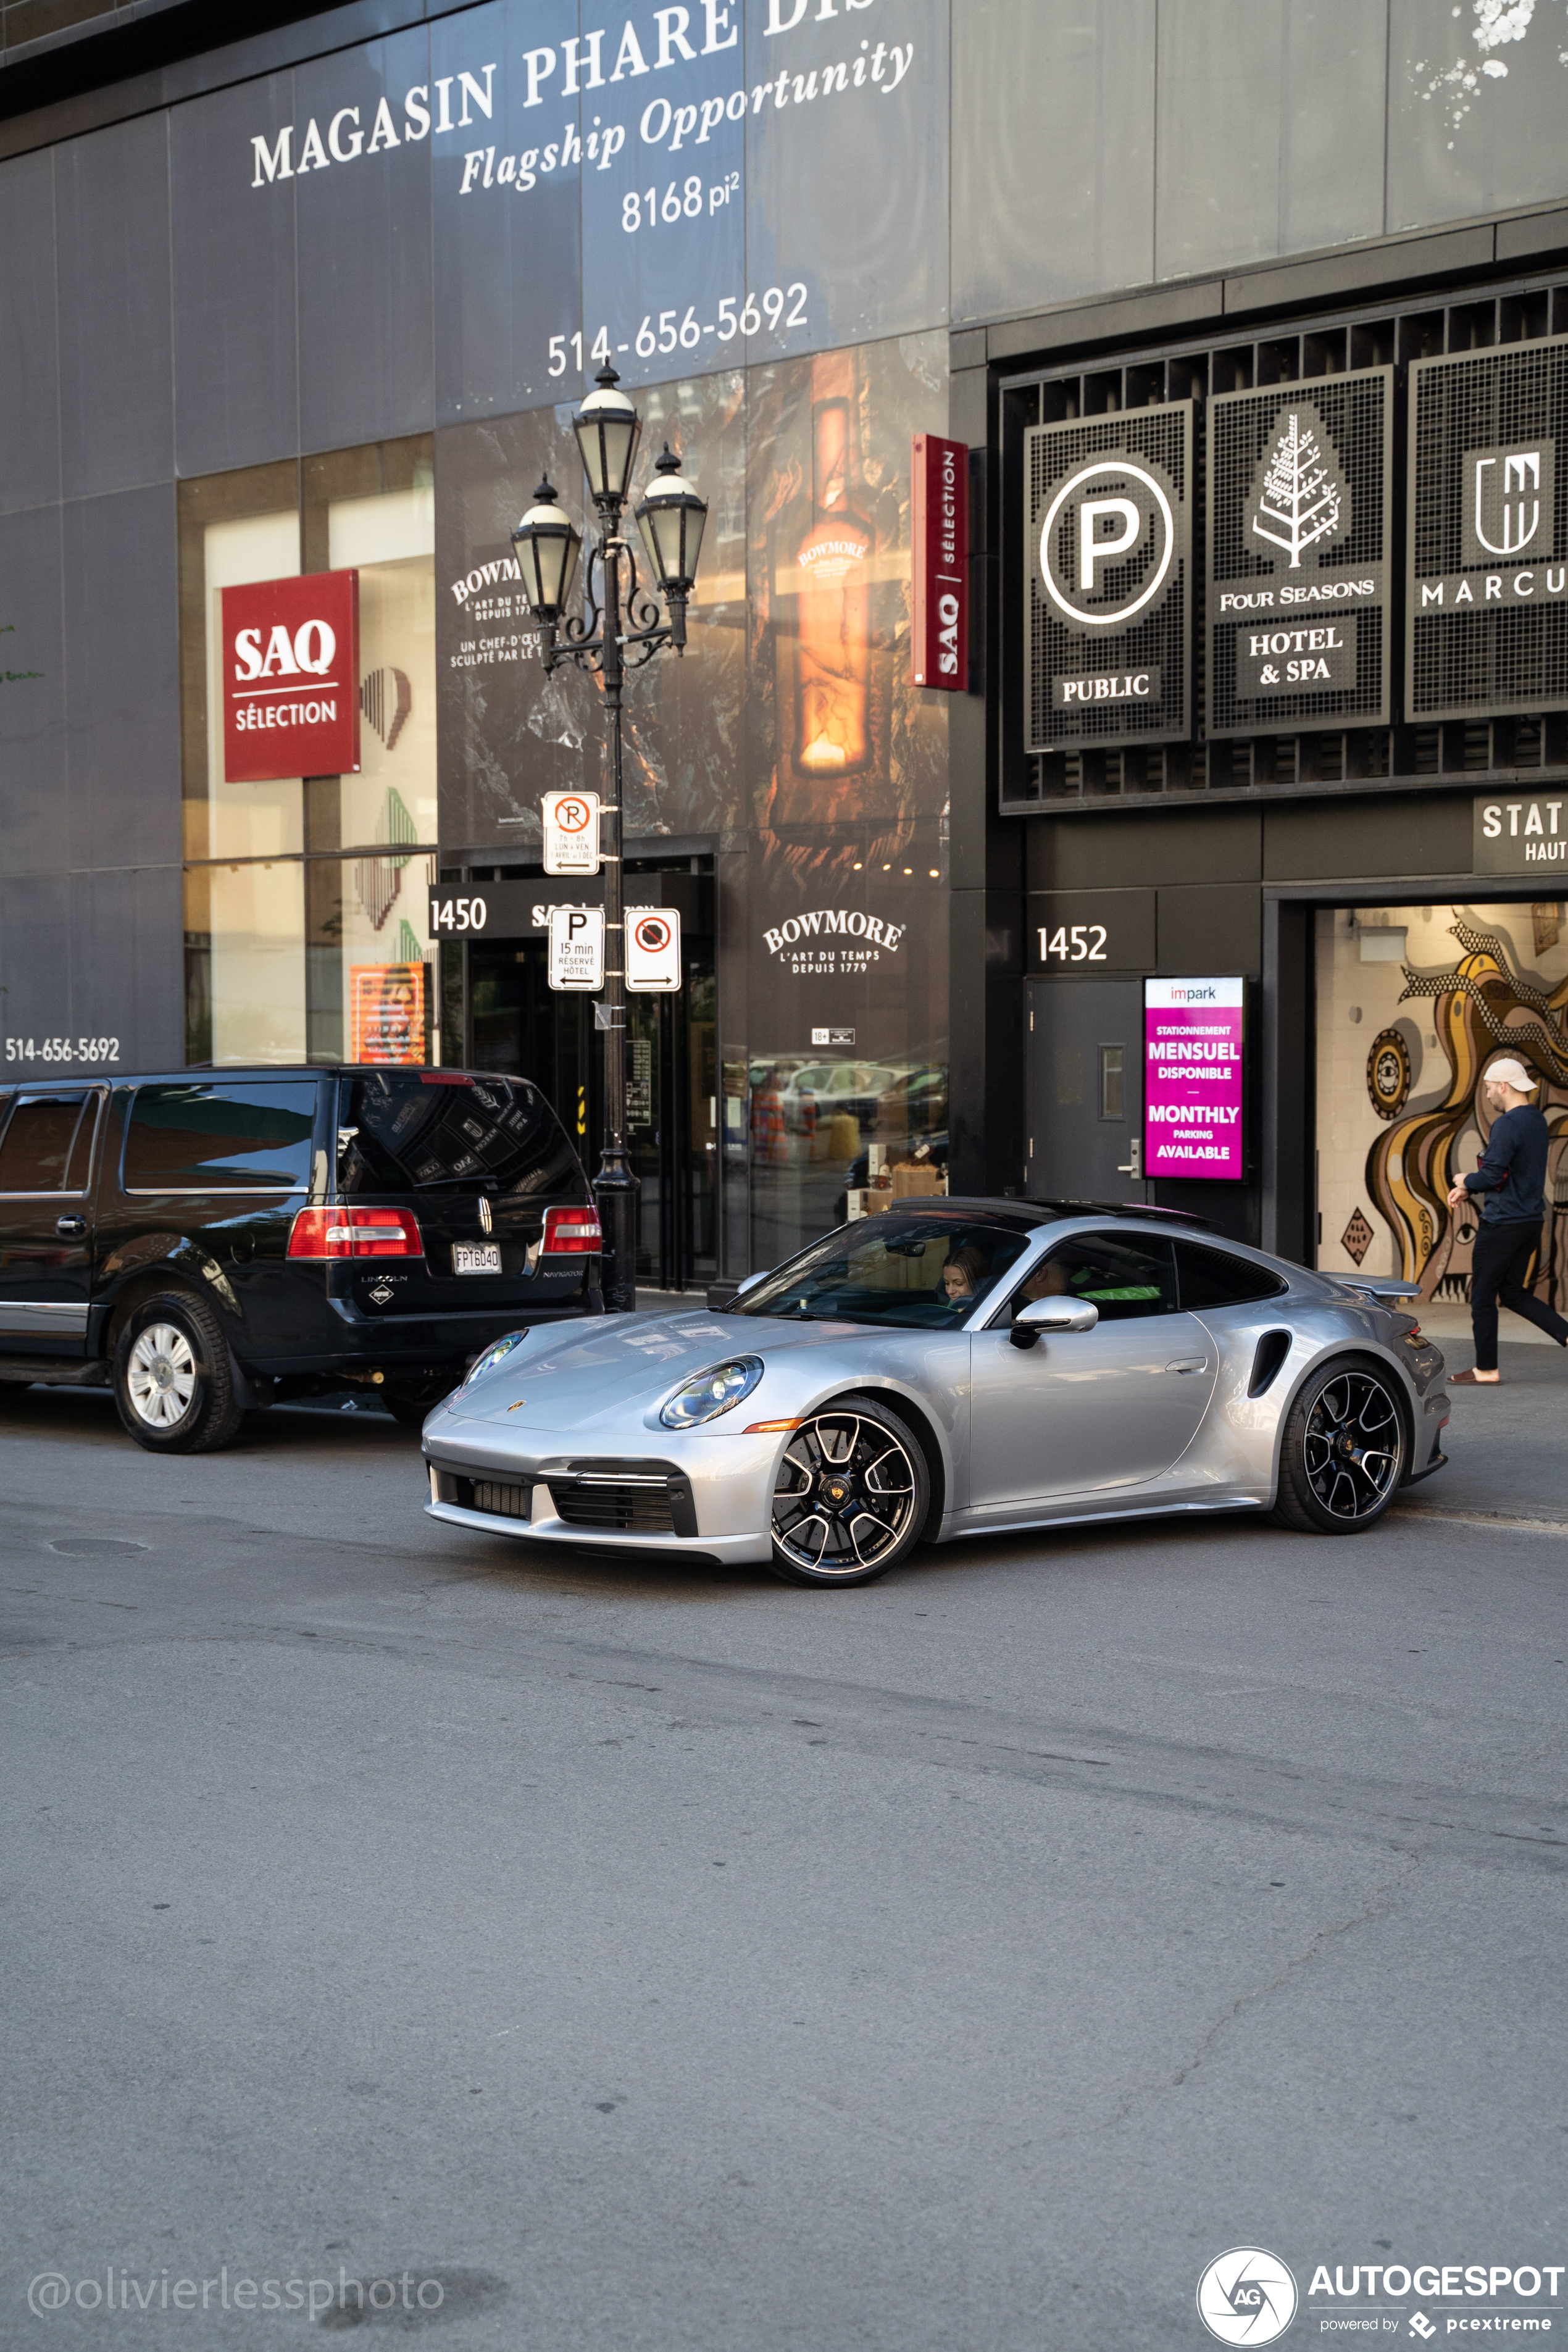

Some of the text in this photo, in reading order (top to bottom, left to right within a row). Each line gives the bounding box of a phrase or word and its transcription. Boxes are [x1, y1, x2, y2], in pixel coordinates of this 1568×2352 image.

[251, 0, 738, 188] MAGASIN PHARE
[459, 40, 914, 194] Flagship Opportunity
[621, 170, 740, 233] 8168 pi²
[548, 283, 807, 377] 514-656-5692
[943, 451, 955, 564] SÉLECTION
[798, 541, 867, 567] BOWMORE
[1080, 498, 1140, 590] P
[451, 557, 522, 606] BOWM
[1422, 567, 1566, 607] MARCU
[465, 598, 494, 612] L'ART
[498, 596, 511, 608] DU
[1220, 580, 1374, 611] FOUR SEASONS
[475, 607, 511, 621] DEPUIS
[460, 640, 476, 653] UN
[939, 594, 960, 675] SAQ
[1249, 627, 1343, 656] HOTEL
[235, 619, 336, 681] SAQ
[451, 649, 494, 668] SCULPTÉ
[498, 649, 517, 662] PAR
[1260, 658, 1331, 685] & SPA
[1062, 673, 1149, 703] PUBLIC
[236, 701, 336, 731] SÉLECTION
[1483, 801, 1563, 838] STAT
[1525, 841, 1567, 861] HAUT
[432, 898, 486, 931] 1450
[569, 913, 587, 941] P
[762, 910, 903, 954] BOWMORE
[1037, 925, 1107, 961] 1452
[559, 956, 594, 965] RÉSERVÉ
[561, 943, 593, 954] 15 min
[780, 951, 880, 962] L'ART DU TEMPS
[564, 967, 589, 975] HÔTEL
[792, 963, 867, 974] DEPUIS 1779
[1170, 986, 1216, 1003] impark
[815, 1032, 827, 1041] 18+
[1156, 1026, 1232, 1036] STATIONNEMENT
[6, 1037, 120, 1061] 514-656-5692
[1149, 1043, 1240, 1060] MENSUEL
[1158, 1067, 1232, 1080] DISPONIBLE
[1149, 1105, 1240, 1124] MONTHLY
[1173, 1130, 1214, 1140] PARKING
[1157, 1145, 1230, 1160] AVAILABLE
